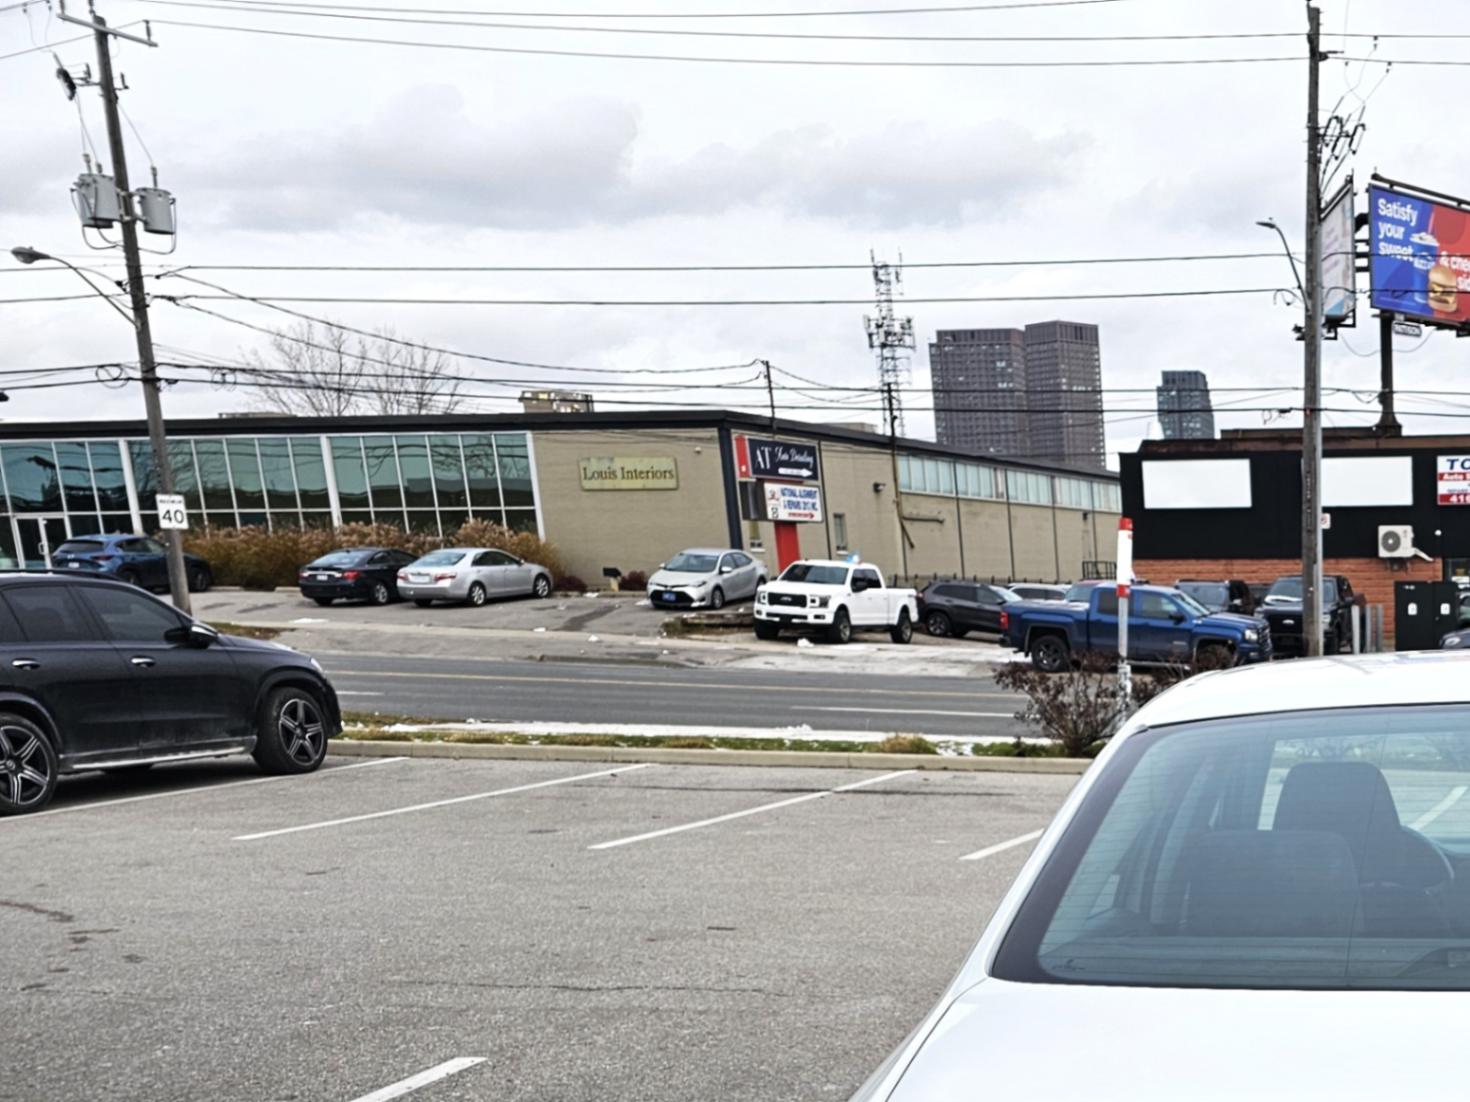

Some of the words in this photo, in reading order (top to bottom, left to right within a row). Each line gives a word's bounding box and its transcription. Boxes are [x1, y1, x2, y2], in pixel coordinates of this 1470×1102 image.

[1378, 198, 1418, 226] Satisfy
[1378, 221, 1405, 239] your
[1440, 251, 1450, 267] &
[755, 446, 772, 469] AT
[582, 466, 618, 480] Louis
[620, 465, 674, 480] Interiors
[162, 509, 185, 524] 40
